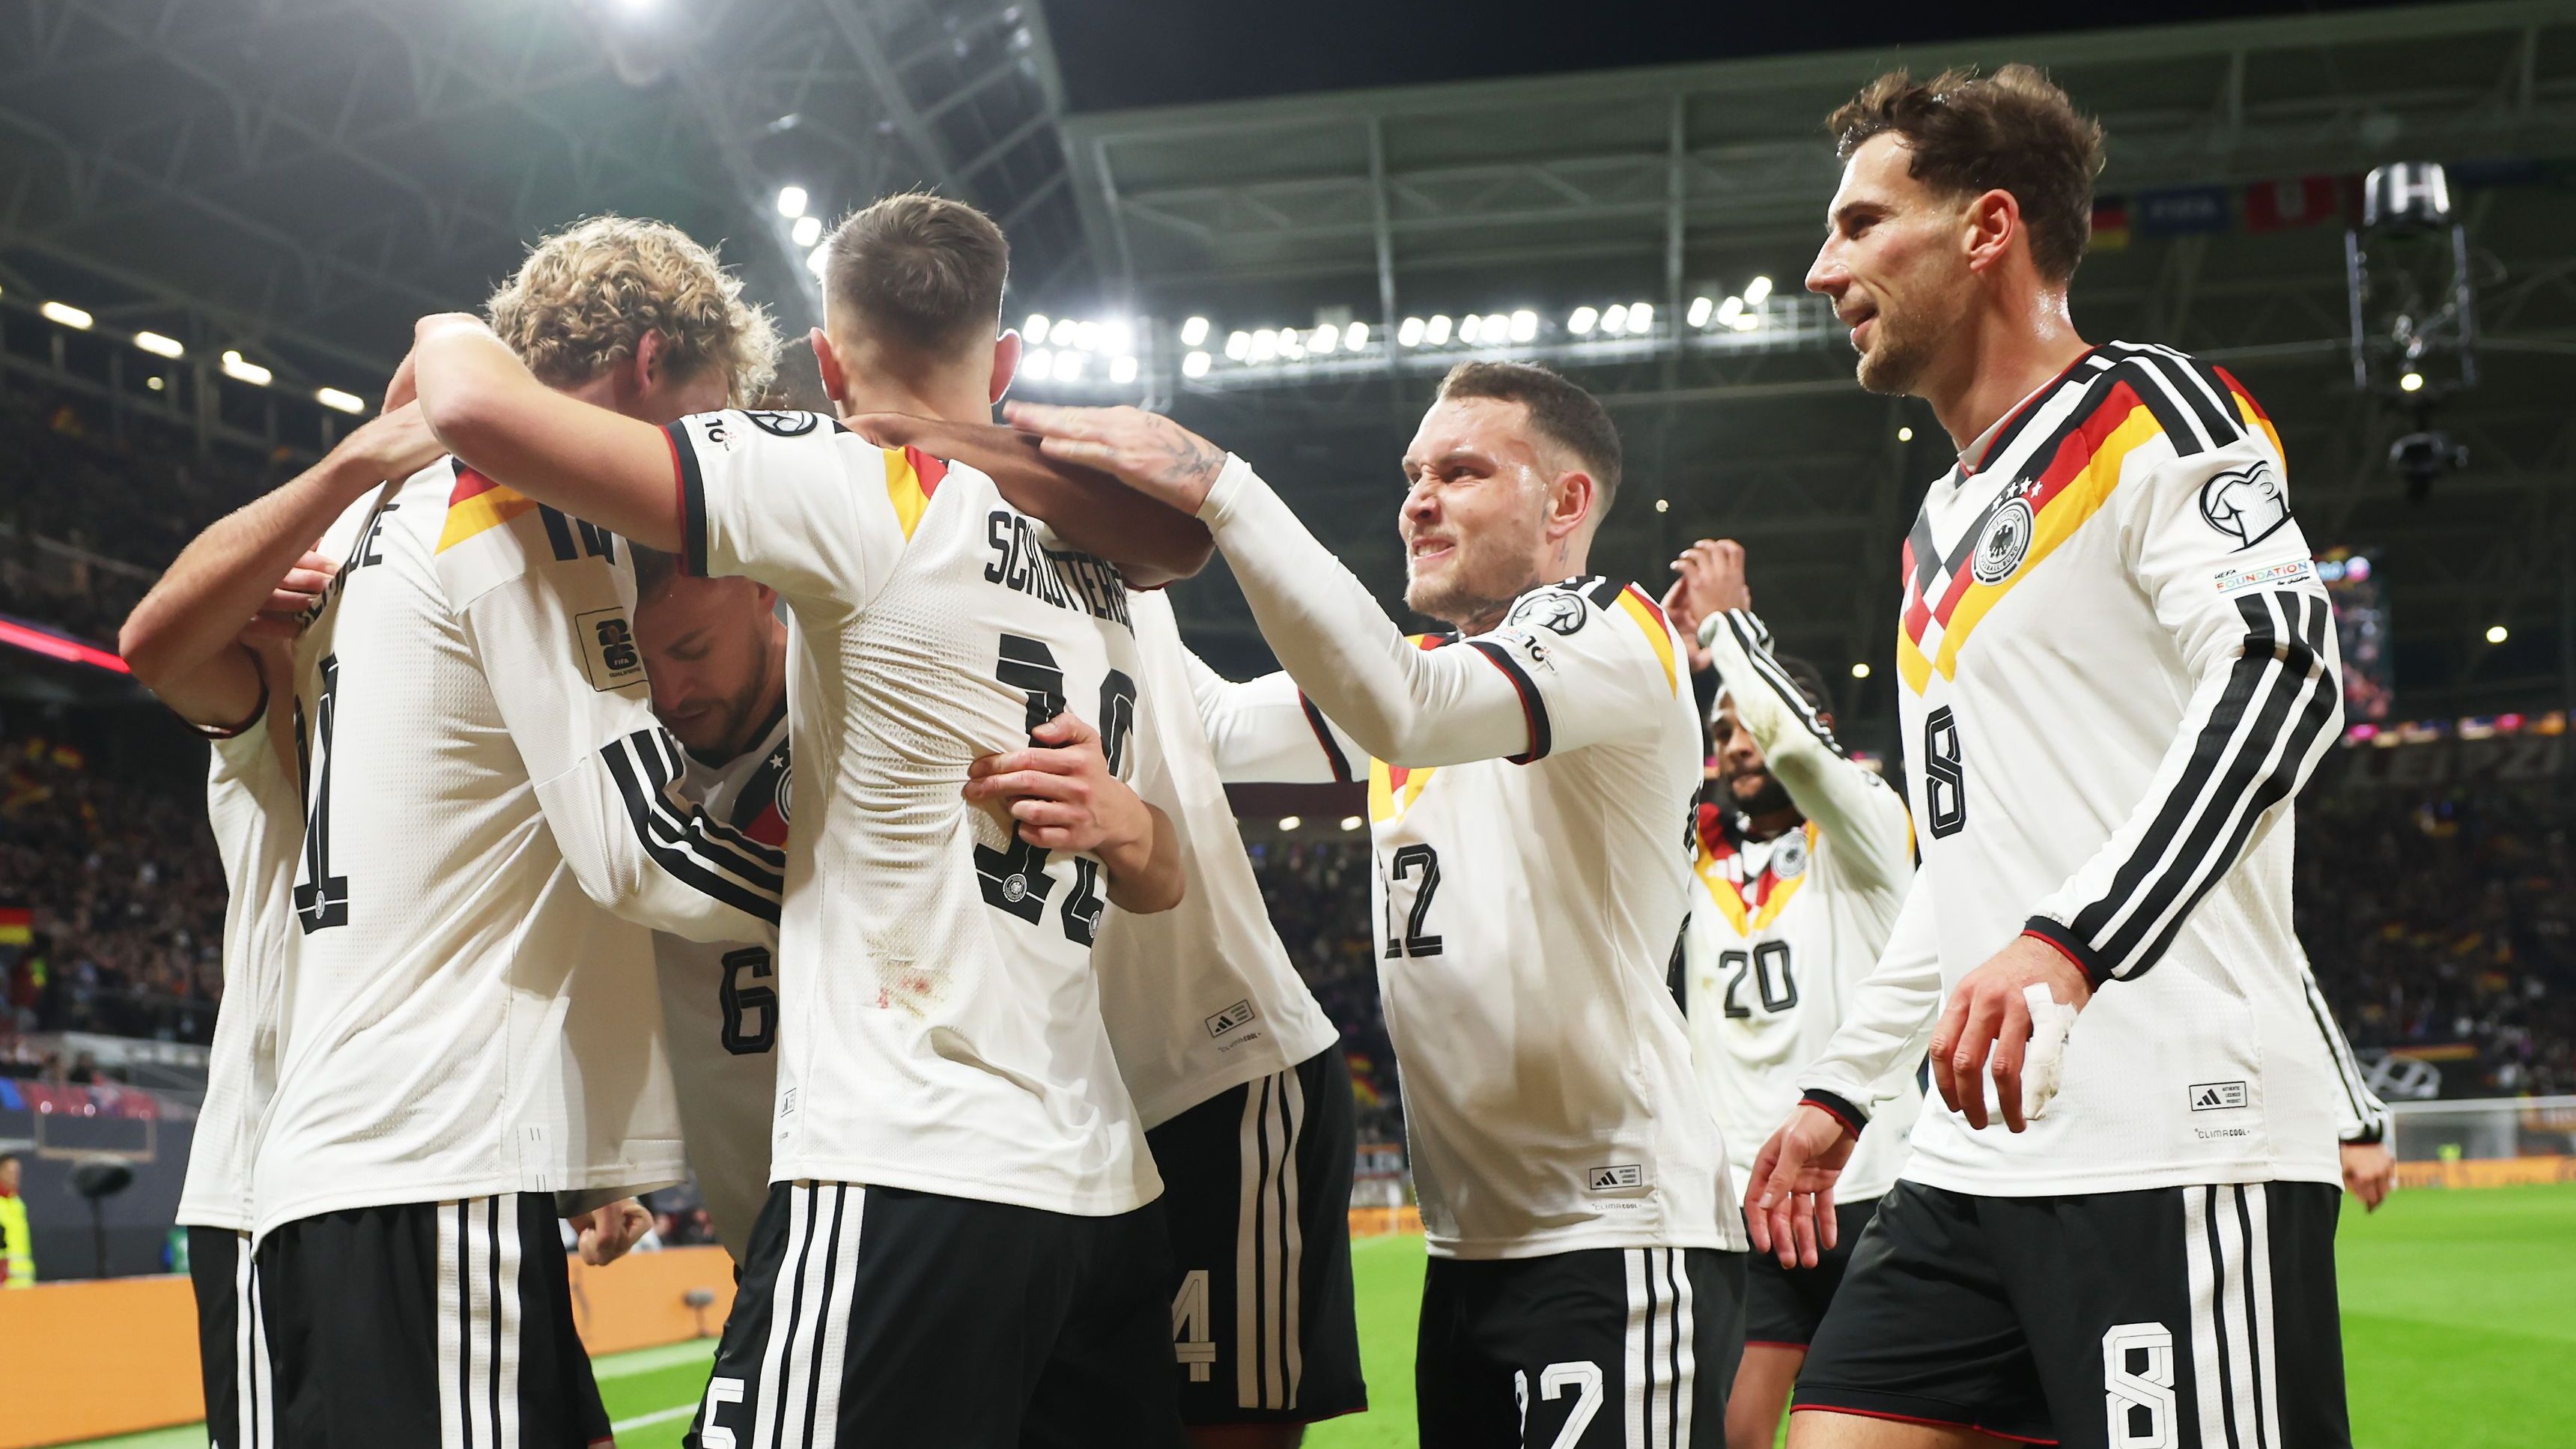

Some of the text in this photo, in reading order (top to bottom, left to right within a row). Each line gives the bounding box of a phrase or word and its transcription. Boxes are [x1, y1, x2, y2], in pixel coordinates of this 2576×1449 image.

[2214, 569, 2237, 580] UEFA
[2217, 562, 2309, 590] FOUNDATION
[1925, 705, 1966, 840] 8
[720, 946, 779, 1055] 6
[1719, 940, 1798, 1019] 20
[1172, 1270, 1216, 1382] 4
[702, 1376, 745, 1449] 5
[2102, 1322, 2179, 1449] 8
